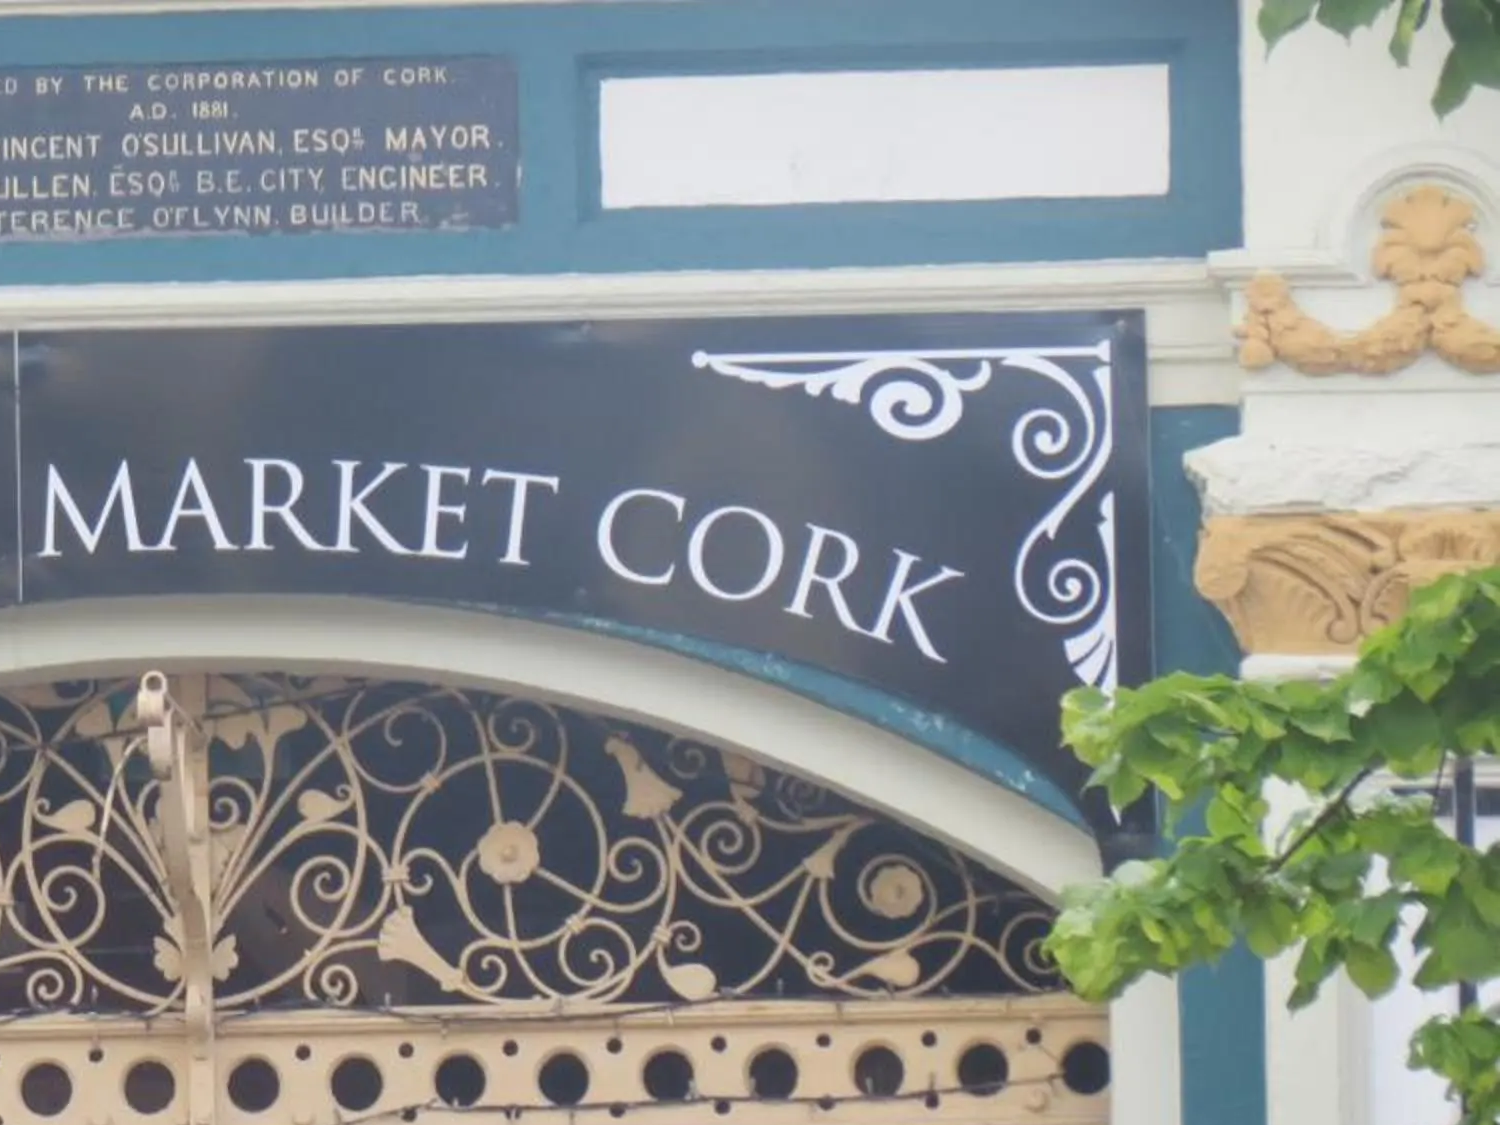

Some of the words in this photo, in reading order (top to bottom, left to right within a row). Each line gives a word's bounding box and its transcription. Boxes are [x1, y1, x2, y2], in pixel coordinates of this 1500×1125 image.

[35, 76, 64, 95] BY
[84, 74, 129, 92] THE
[148, 69, 319, 92] CORPORATION
[334, 68, 365, 88] OF
[37, 457, 560, 567] MARKET
[596, 488, 965, 665] CORK
